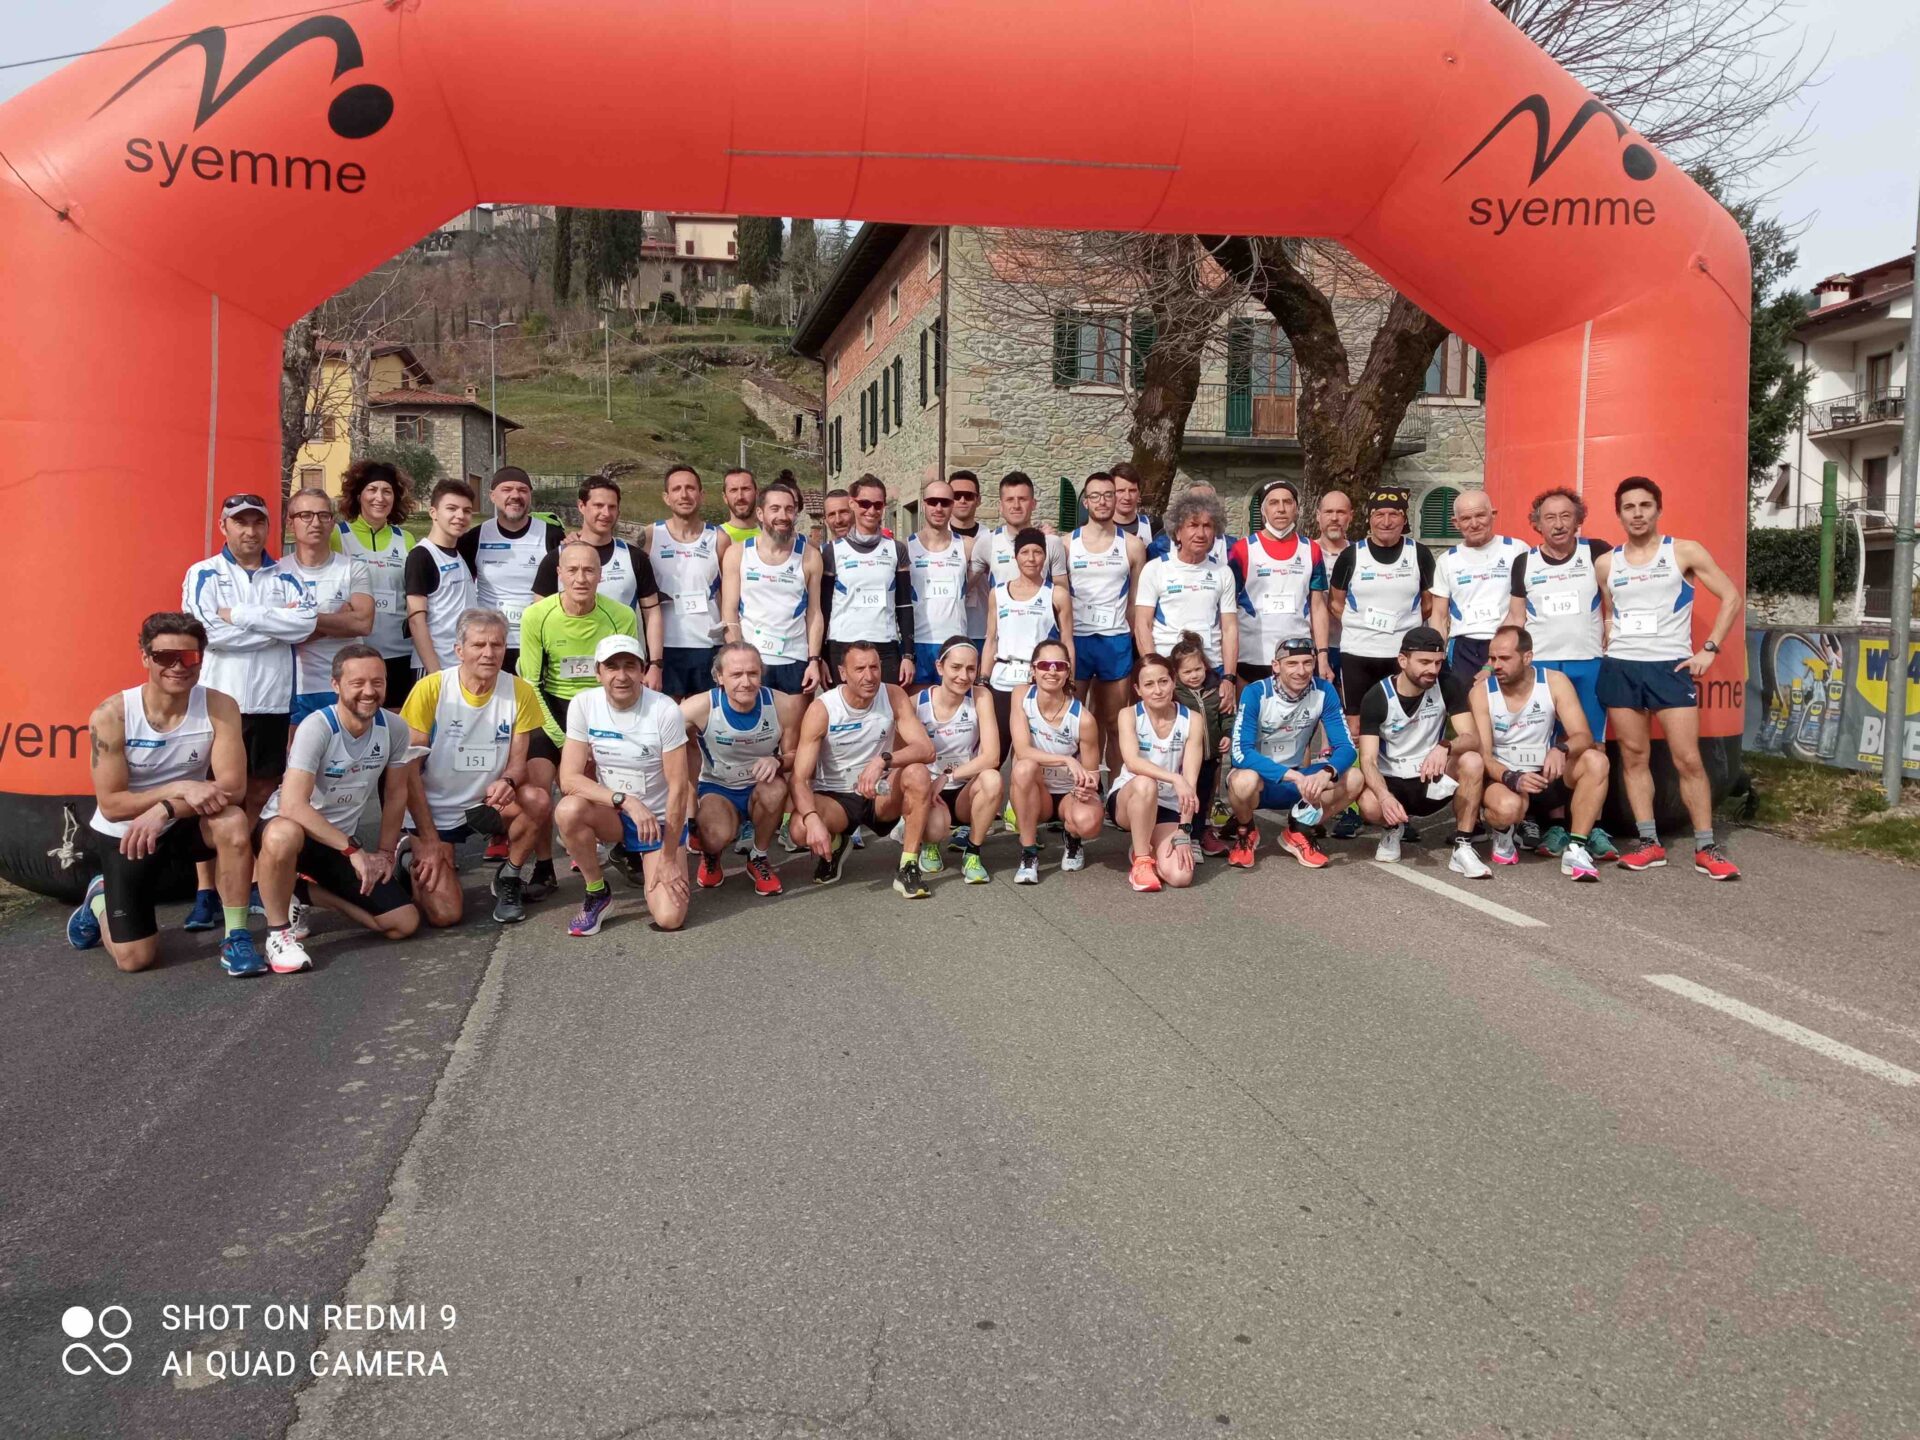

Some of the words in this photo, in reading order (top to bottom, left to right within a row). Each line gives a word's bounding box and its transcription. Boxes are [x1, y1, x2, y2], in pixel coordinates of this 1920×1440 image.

[125, 137, 367, 194] syemme
[1469, 196, 1656, 236] syemme
[932, 585, 949, 596] 116
[862, 594, 879, 604] 168
[686, 601, 697, 610] 23
[1273, 601, 1284, 610] 73
[1552, 601, 1571, 612] 149
[1091, 613, 1107, 624] 115
[1371, 616, 1387, 628] 141
[1635, 620, 1642, 630] 2
[762, 639, 774, 650] 20
[570, 664, 589, 674] 152
[1273, 745, 1285, 753] 19
[466, 755, 485, 767] 151
[1519, 754, 1537, 763] 111
[947, 761, 959, 770] 85
[618, 779, 633, 791] 76
[337, 793, 353, 804] 60
